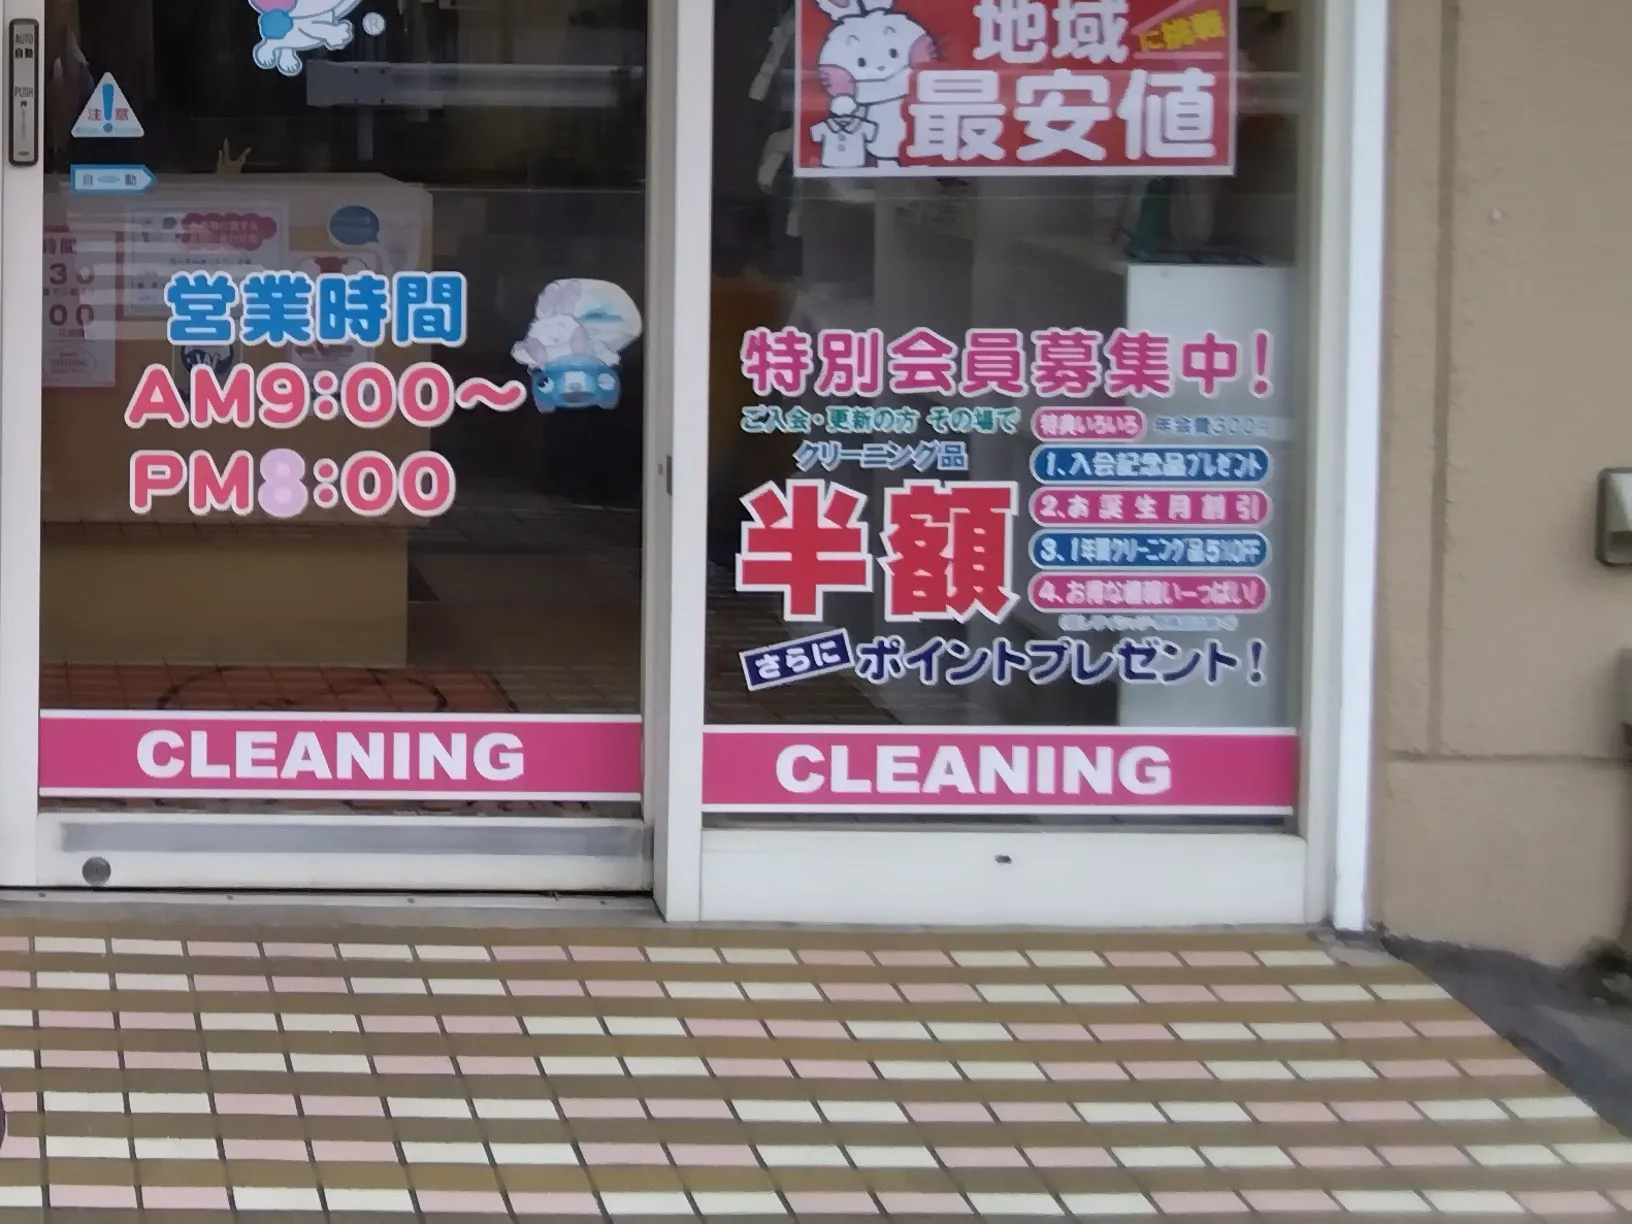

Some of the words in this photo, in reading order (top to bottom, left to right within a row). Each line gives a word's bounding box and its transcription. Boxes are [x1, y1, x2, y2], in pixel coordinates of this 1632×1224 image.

[907, 68, 1216, 161] 最安値
[165, 270, 467, 347] 営業時間
[740, 327, 1274, 397] 特別会員募集中!
[129, 448, 455, 518] PM8:00
[793, 439, 968, 472] クリーニング品
[735, 478, 1019, 623] 半額
[756, 642, 843, 676] さらに
[856, 637, 1267, 687] ポイントプレゼント!
[137, 729, 524, 781] CLEANING
[776, 743, 1173, 794] CLEANING
